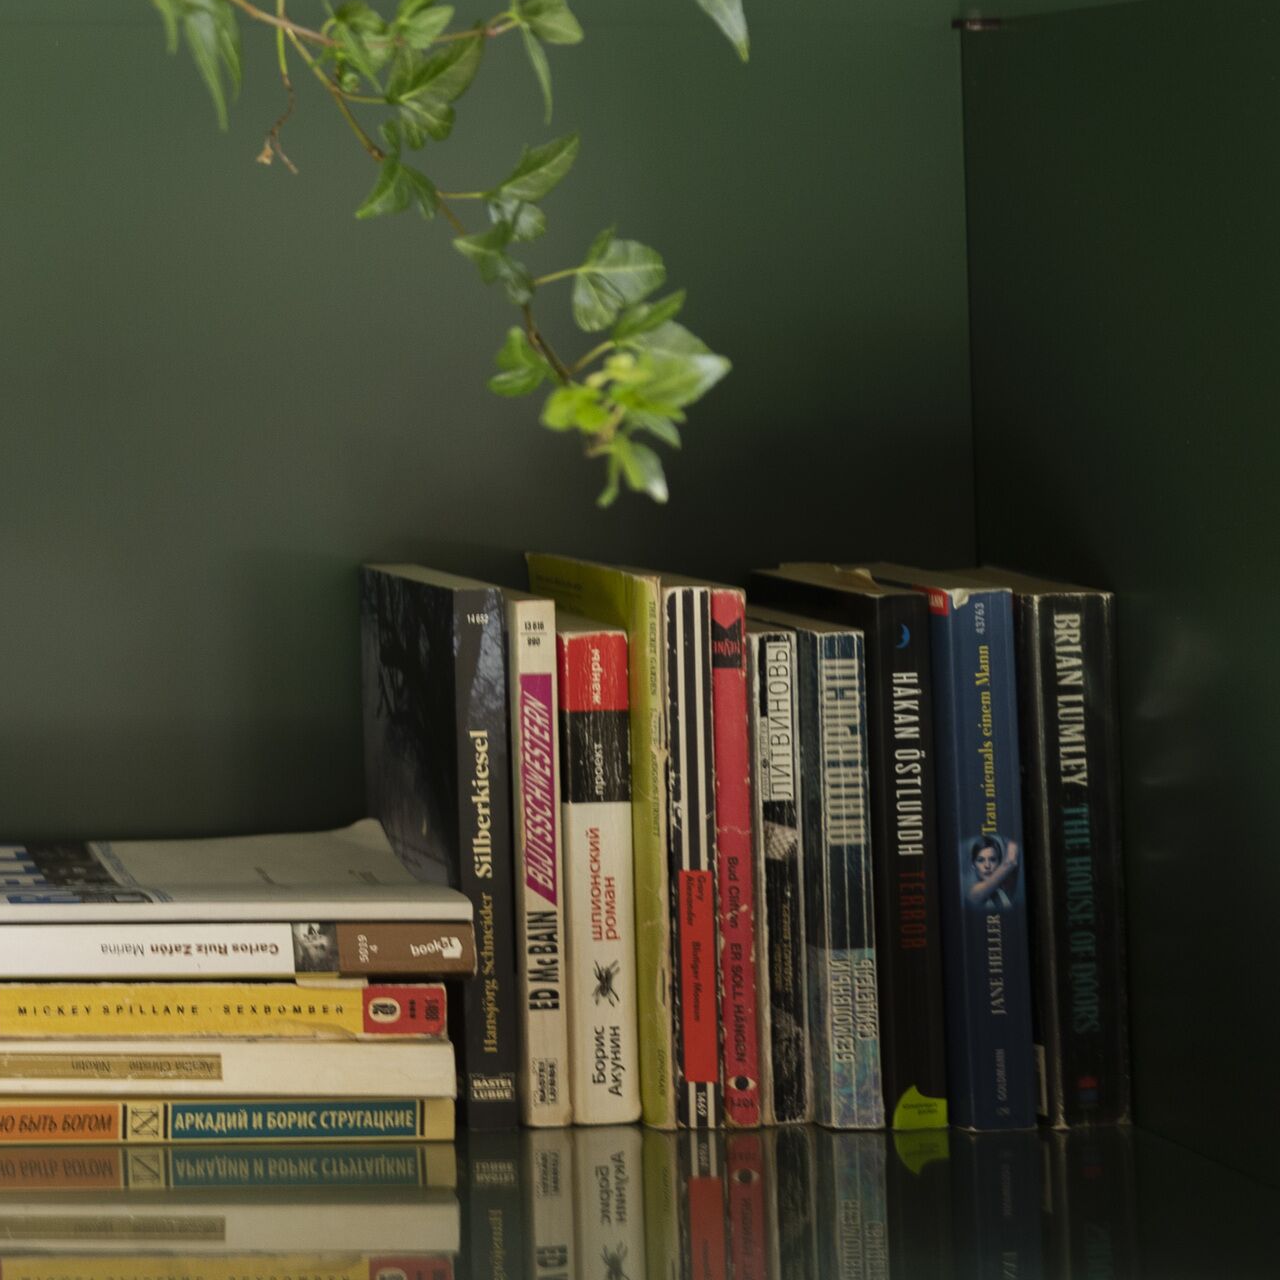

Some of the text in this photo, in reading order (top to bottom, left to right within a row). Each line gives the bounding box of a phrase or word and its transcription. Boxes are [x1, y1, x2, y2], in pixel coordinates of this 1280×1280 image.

[767, 643, 793, 799] ЛИТВИНОВЫ
[1052, 612, 1089, 788] BRIAN LUMLEY
[593, 741, 605, 797] проект
[891, 671, 926, 857] HÅKAN ÖSTLUNDH
[975, 644, 998, 838] Trau niemals einem Mann
[522, 689, 556, 892] BLUTSSCHWESTERN
[1062, 804, 1090, 849] THE
[468, 728, 501, 1054] Hansjörg Schneider Silberkiesel
[586, 826, 604, 943] шпионский
[604, 875, 622, 942] роман
[899, 870, 928, 950] TERROR
[1065, 855, 1095, 927] HOUSE
[99, 941, 280, 958] Carlos Ruiz Zafón Marina
[987, 914, 1009, 1016] JANE HELLER
[17, 1004, 345, 1017] MICKEY SPILLANE SEXBOMBER
[528, 988, 561, 1012] ED
[471, 1078, 513, 1089] BASTEI
[592, 1024, 610, 1086] Борис
[608, 1025, 627, 1098] Акунин
[17, 1113, 59, 1134] БЫТЬ
[61, 1113, 114, 1134] БОГОМ
[174, 1107, 415, 1134] АРКАДИЙ И БОРИС СТРУГАЦКИЕ
